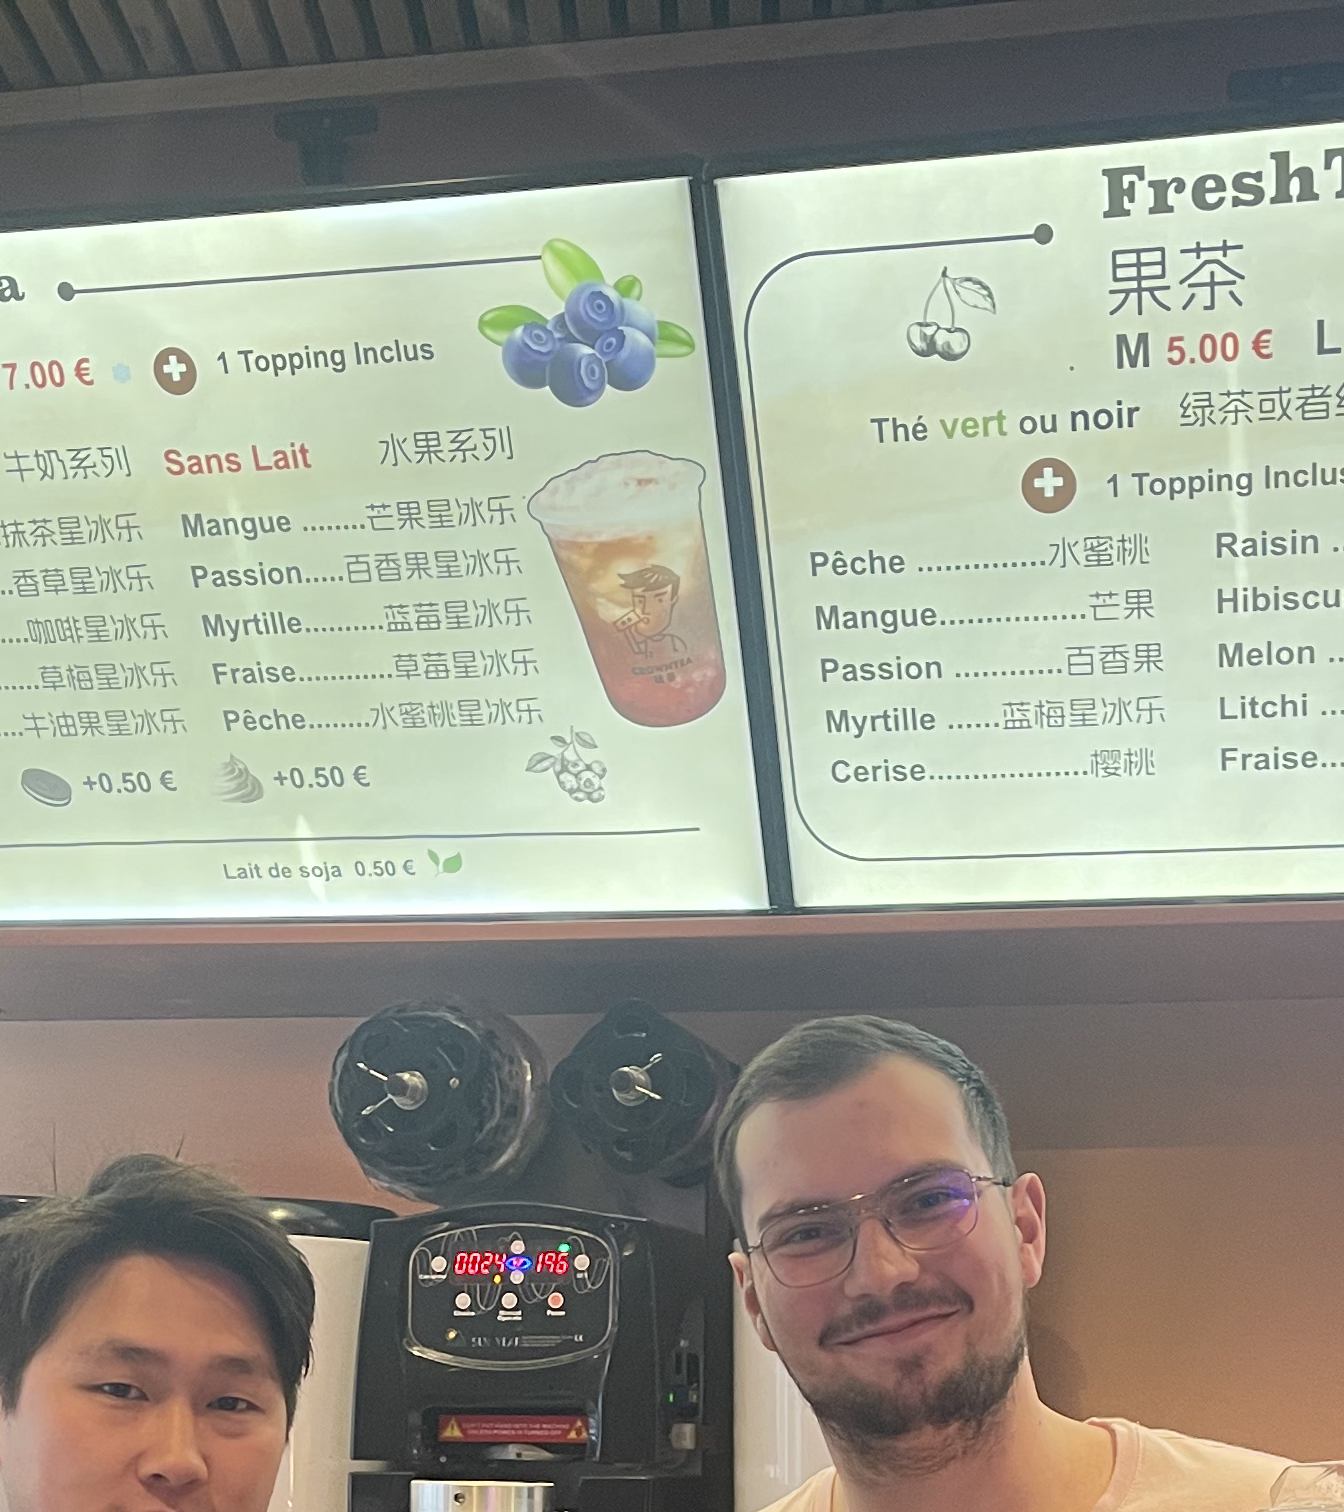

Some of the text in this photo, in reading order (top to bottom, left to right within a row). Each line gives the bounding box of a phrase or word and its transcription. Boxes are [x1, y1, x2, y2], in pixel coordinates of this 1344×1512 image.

[1108, 239, 1246, 316] 果茶
[237, 339, 435, 377] Topping Inclus
[1115, 332, 1150, 370] M
[1166, 331, 1240, 367] 5.00
[1251, 329, 1273, 360] €
[1316, 318, 1342, 356] L
[1, 359, 65, 391] 7.00
[74, 357, 95, 386] €
[870, 400, 1141, 444] Thé vert ou noir
[163, 442, 312, 476] Sans Lait
[378, 425, 514, 467] 水果系列
[3, 445, 133, 483] 牛奶系列
[1131, 468, 1254, 500] Topping
[181, 513, 291, 541] Mangue
[365, 495, 517, 531] 芒果星冰乐
[0, 513, 144, 549] 抹茶星冰乐
[1216, 529, 1320, 559] Raisin
[343, 547, 523, 584] 百香果星冰乐
[809, 549, 906, 577] Pêche
[1048, 532, 1150, 569] 水蜜桃
[12, 564, 155, 598] 香草星冰乐
[190, 562, 302, 589] Passion
[384, 597, 533, 633] 蓝莓星冰乐
[815, 605, 938, 635] Mangue
[1088, 589, 1155, 622] 芒果
[26, 612, 169, 645] 咖啡星冰乐
[202, 611, 302, 643] Myrtille
[392, 648, 540, 681] 草莓星冰乐
[820, 655, 943, 683] Passion
[1064, 642, 1164, 676] 百香果
[1218, 641, 1316, 668] Melon
[211, 662, 296, 685] Fraise
[223, 709, 306, 733] Pêche
[370, 697, 544, 730] 水蜜桃星冰乐
[1219, 693, 1308, 720] Litchi
[22, 708, 188, 738] 牛油果星冰乐
[825, 707, 936, 739] Myrtille
[831, 758, 926, 784] Cerise
[1090, 747, 1156, 779] 樱桃
[1220, 746, 1318, 772] Fraise
[83, 771, 151, 795] +0.50
[273, 766, 344, 789] +0.50
[222, 860, 395, 882] Lait de soja 0.50
[454, 1251, 569, 1275] 0024 196
